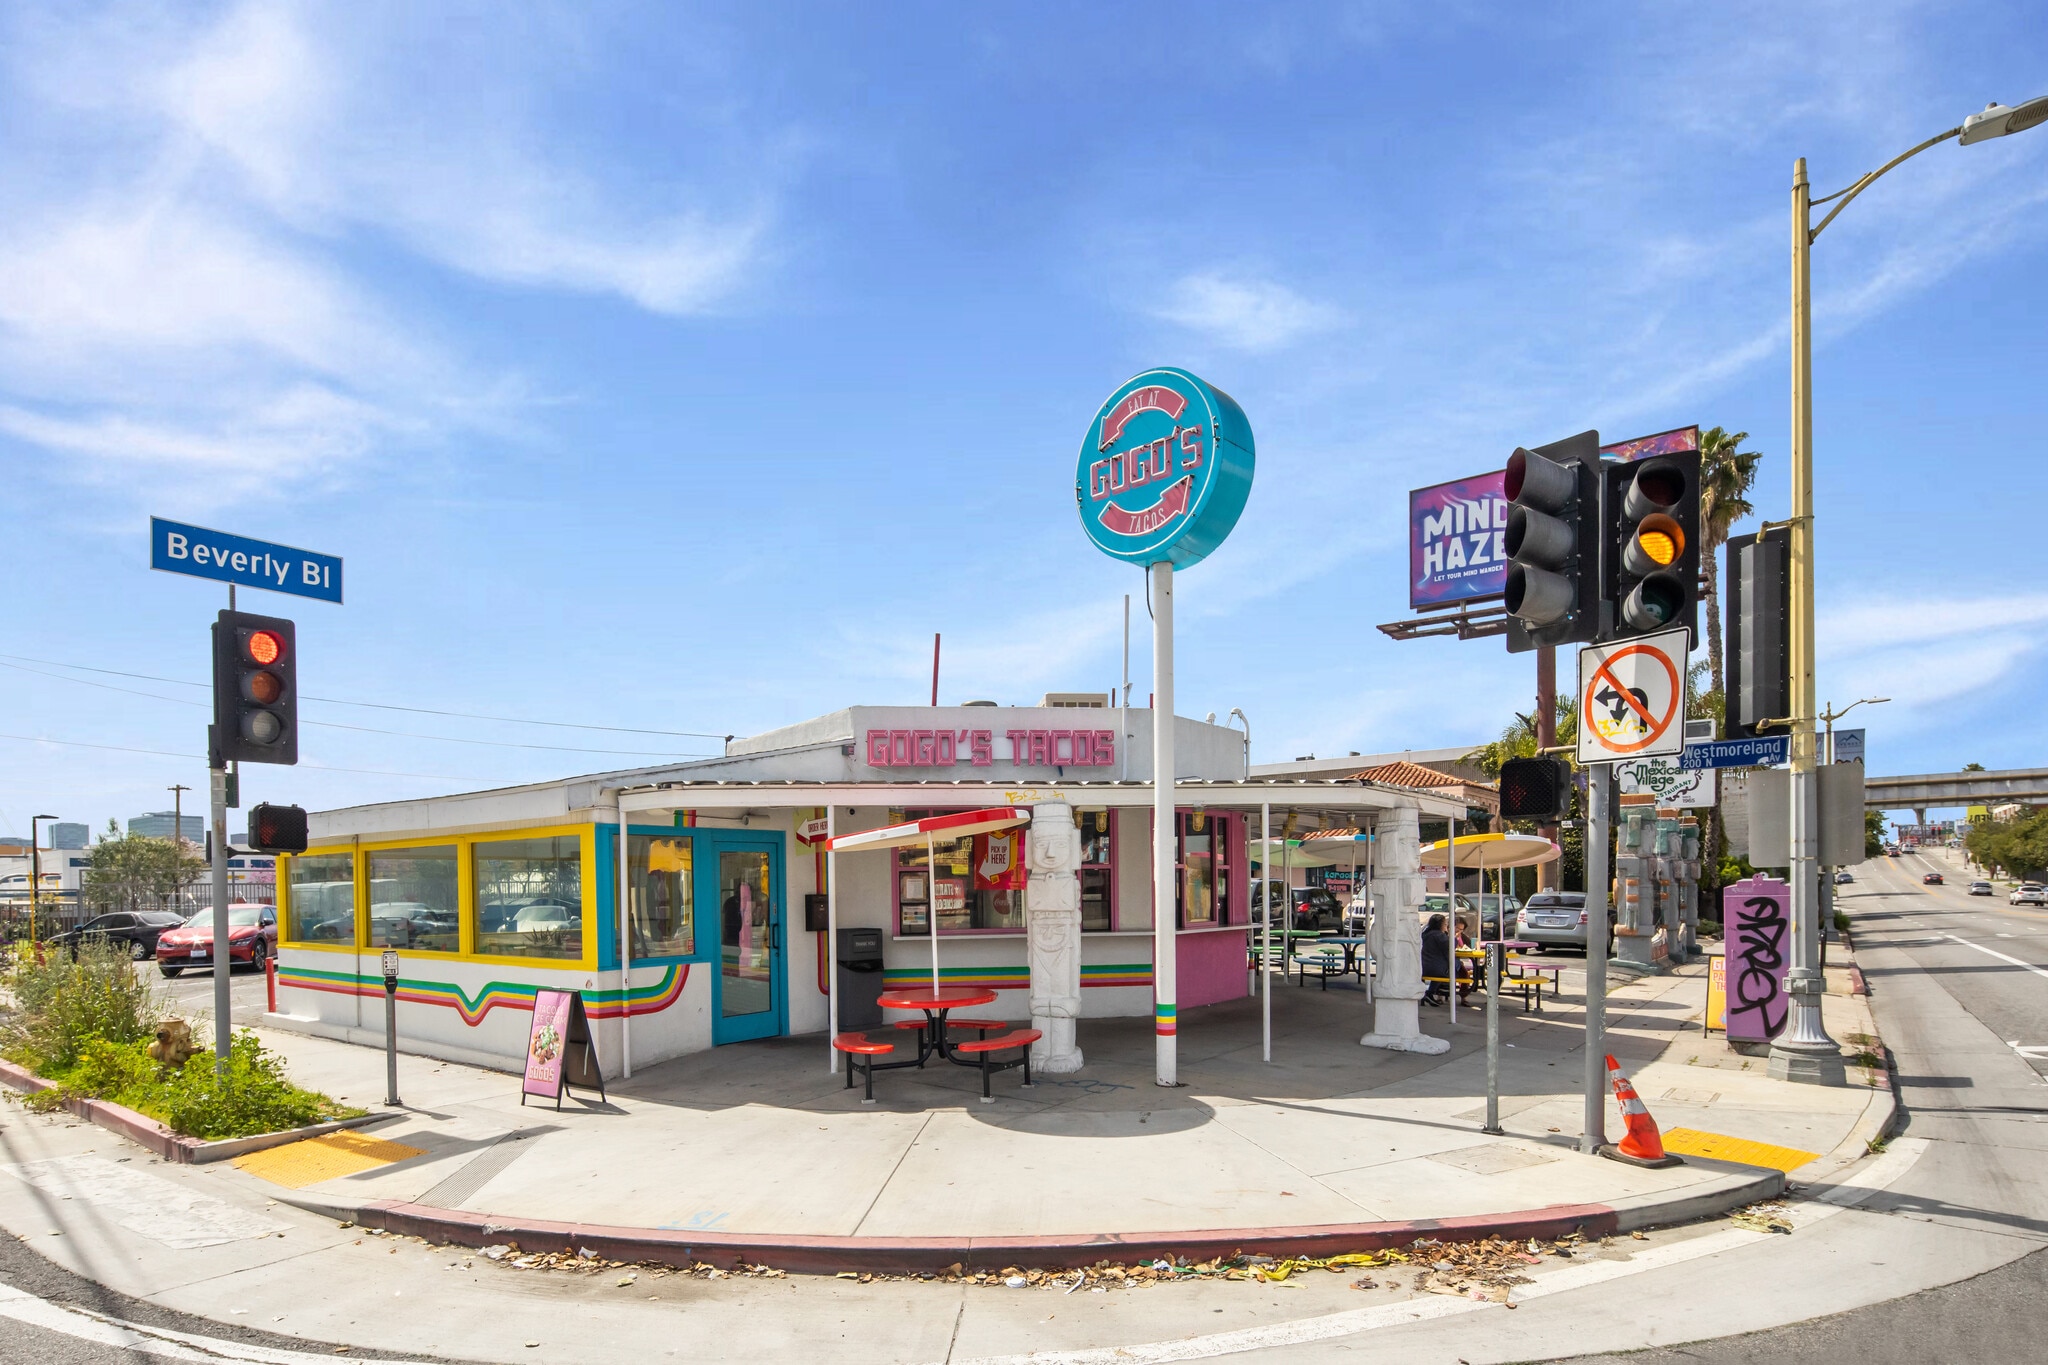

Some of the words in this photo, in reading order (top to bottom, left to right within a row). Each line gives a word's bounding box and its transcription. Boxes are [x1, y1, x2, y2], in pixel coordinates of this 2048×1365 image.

[1128, 394, 1144, 413] EAT
[1149, 391, 1159, 407] AT
[1090, 424, 1202, 501] GOGO'S
[1129, 508, 1167, 532] TACOS
[1424, 498, 1507, 544] MIND
[168, 532, 290, 585] Beverly
[302, 560, 330, 588] Bl
[1424, 531, 1507, 576] HAZE
[1447, 571, 1462, 580] YOUR
[1463, 569, 1478, 577] MIND
[1480, 565, 1504, 574] WANDER
[867, 729, 993, 767] GOGO'S
[1006, 729, 1115, 767] TACOS
[1684, 739, 1781, 760] Westmoreland
[1769, 753, 1781, 763] Av
[1636, 764, 1688, 777] Mexican
[1650, 758, 1667, 767] the
[1683, 758, 1701, 769] 200
[1706, 757, 1713, 768] N
[1624, 770, 1674, 792] Village
[808, 823, 819, 832] ORDER
[820, 821, 828, 830] HER
[991, 854, 1006, 864] HERE
[1001, 845, 1008, 853] UP
